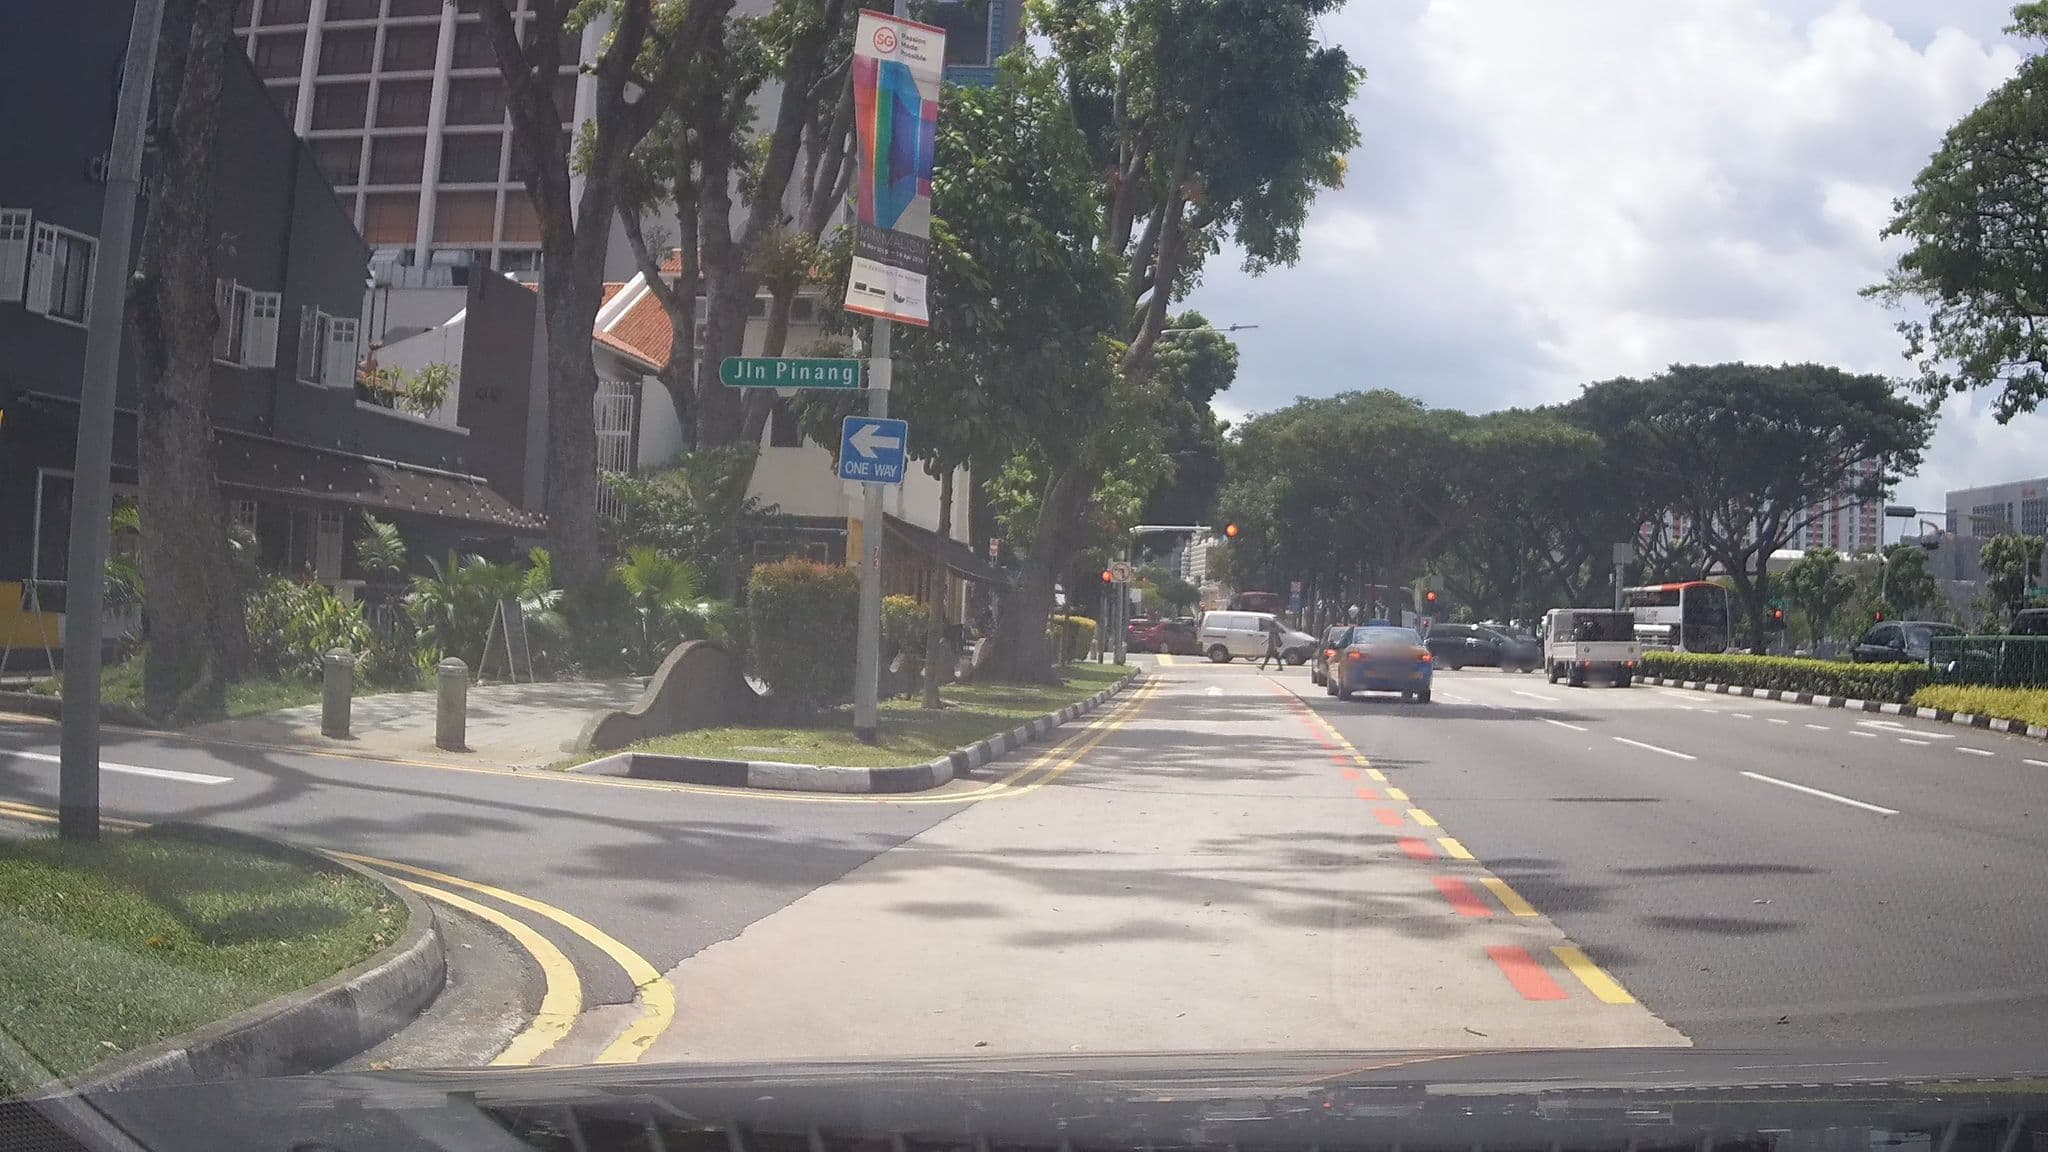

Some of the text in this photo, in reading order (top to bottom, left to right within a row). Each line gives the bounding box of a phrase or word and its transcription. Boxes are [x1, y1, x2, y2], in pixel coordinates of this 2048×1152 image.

[877, 33, 894, 46] SG
[734, 361, 853, 385] Jln Pinang
[844, 460, 898, 478] ONE WAY
